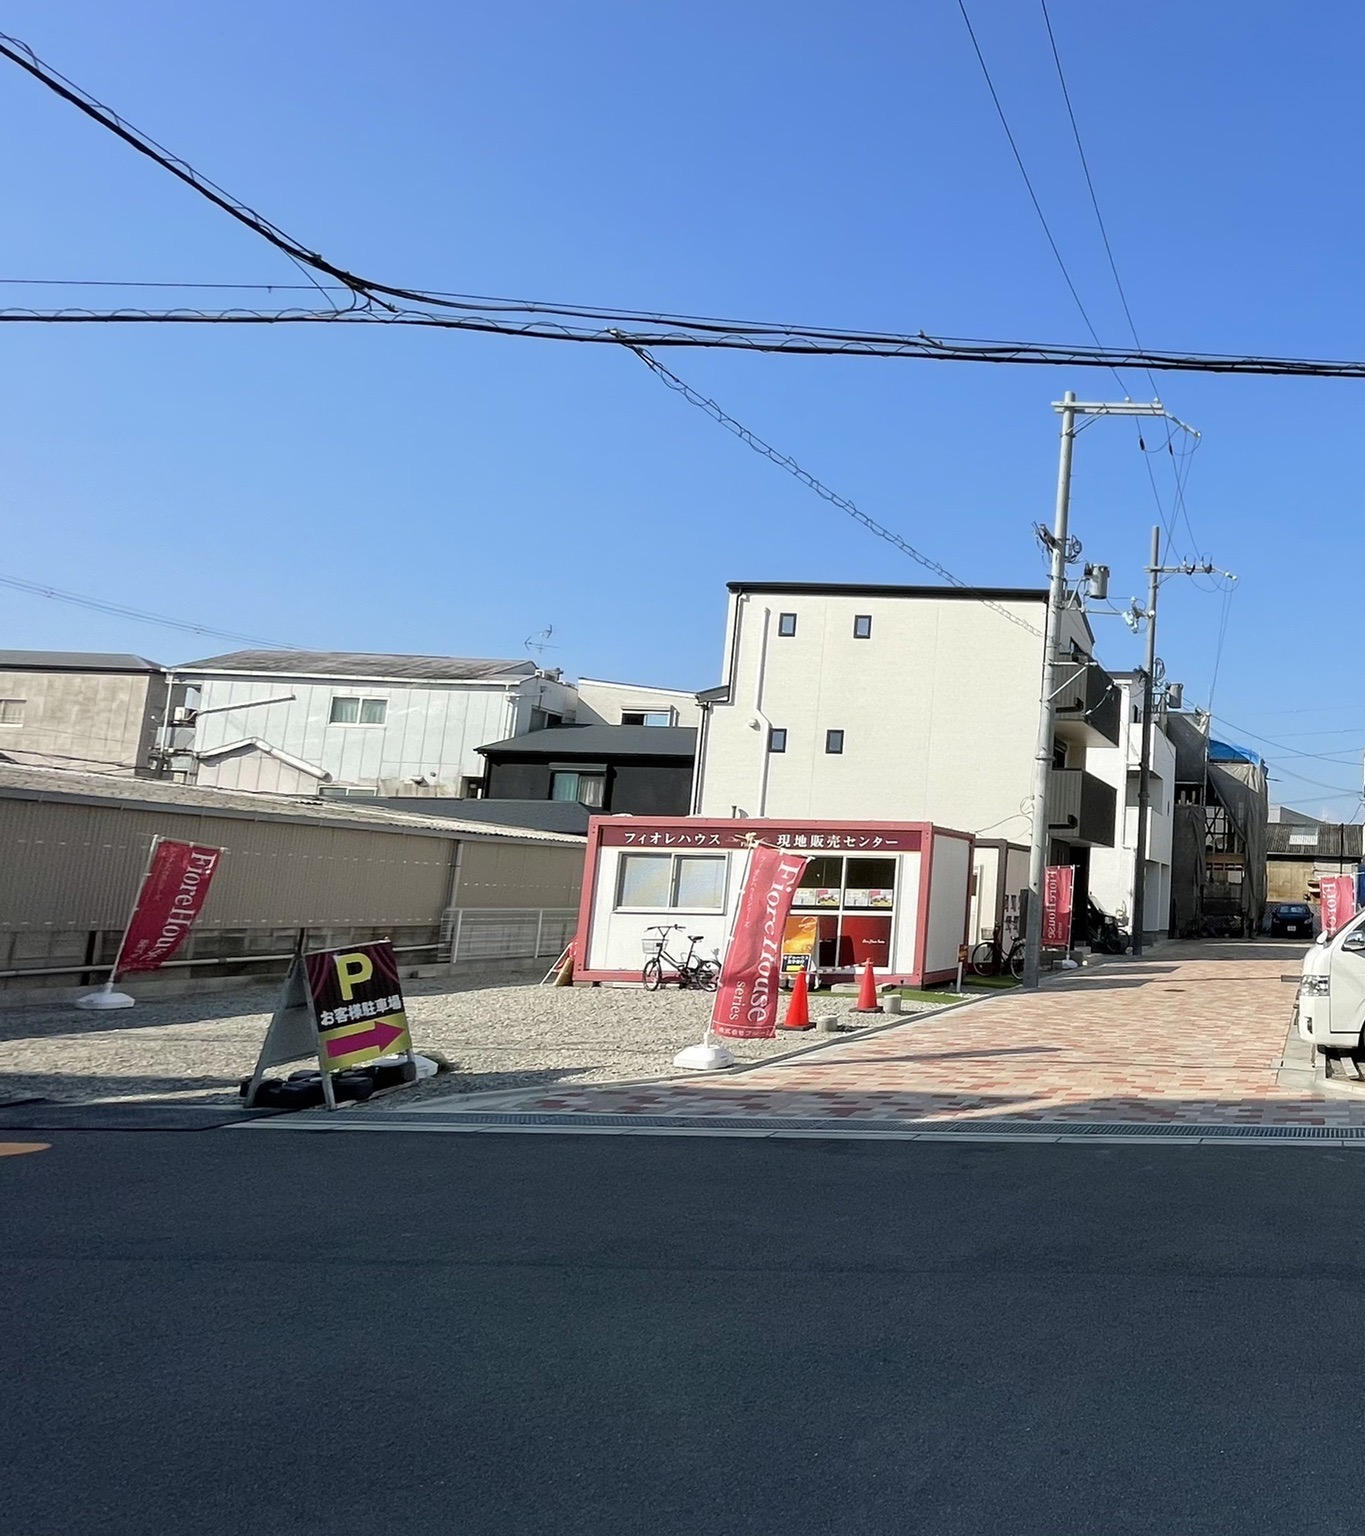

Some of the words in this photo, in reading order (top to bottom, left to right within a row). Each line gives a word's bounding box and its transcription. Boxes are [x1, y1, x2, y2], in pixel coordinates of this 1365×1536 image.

[624, 832, 721, 845] フィオレハウス
[777, 834, 899, 848] 現地販売センター
[333, 953, 373, 1001] P
[320, 994, 402, 1026] お客様駐車場
[729, 981, 746, 1020] series
